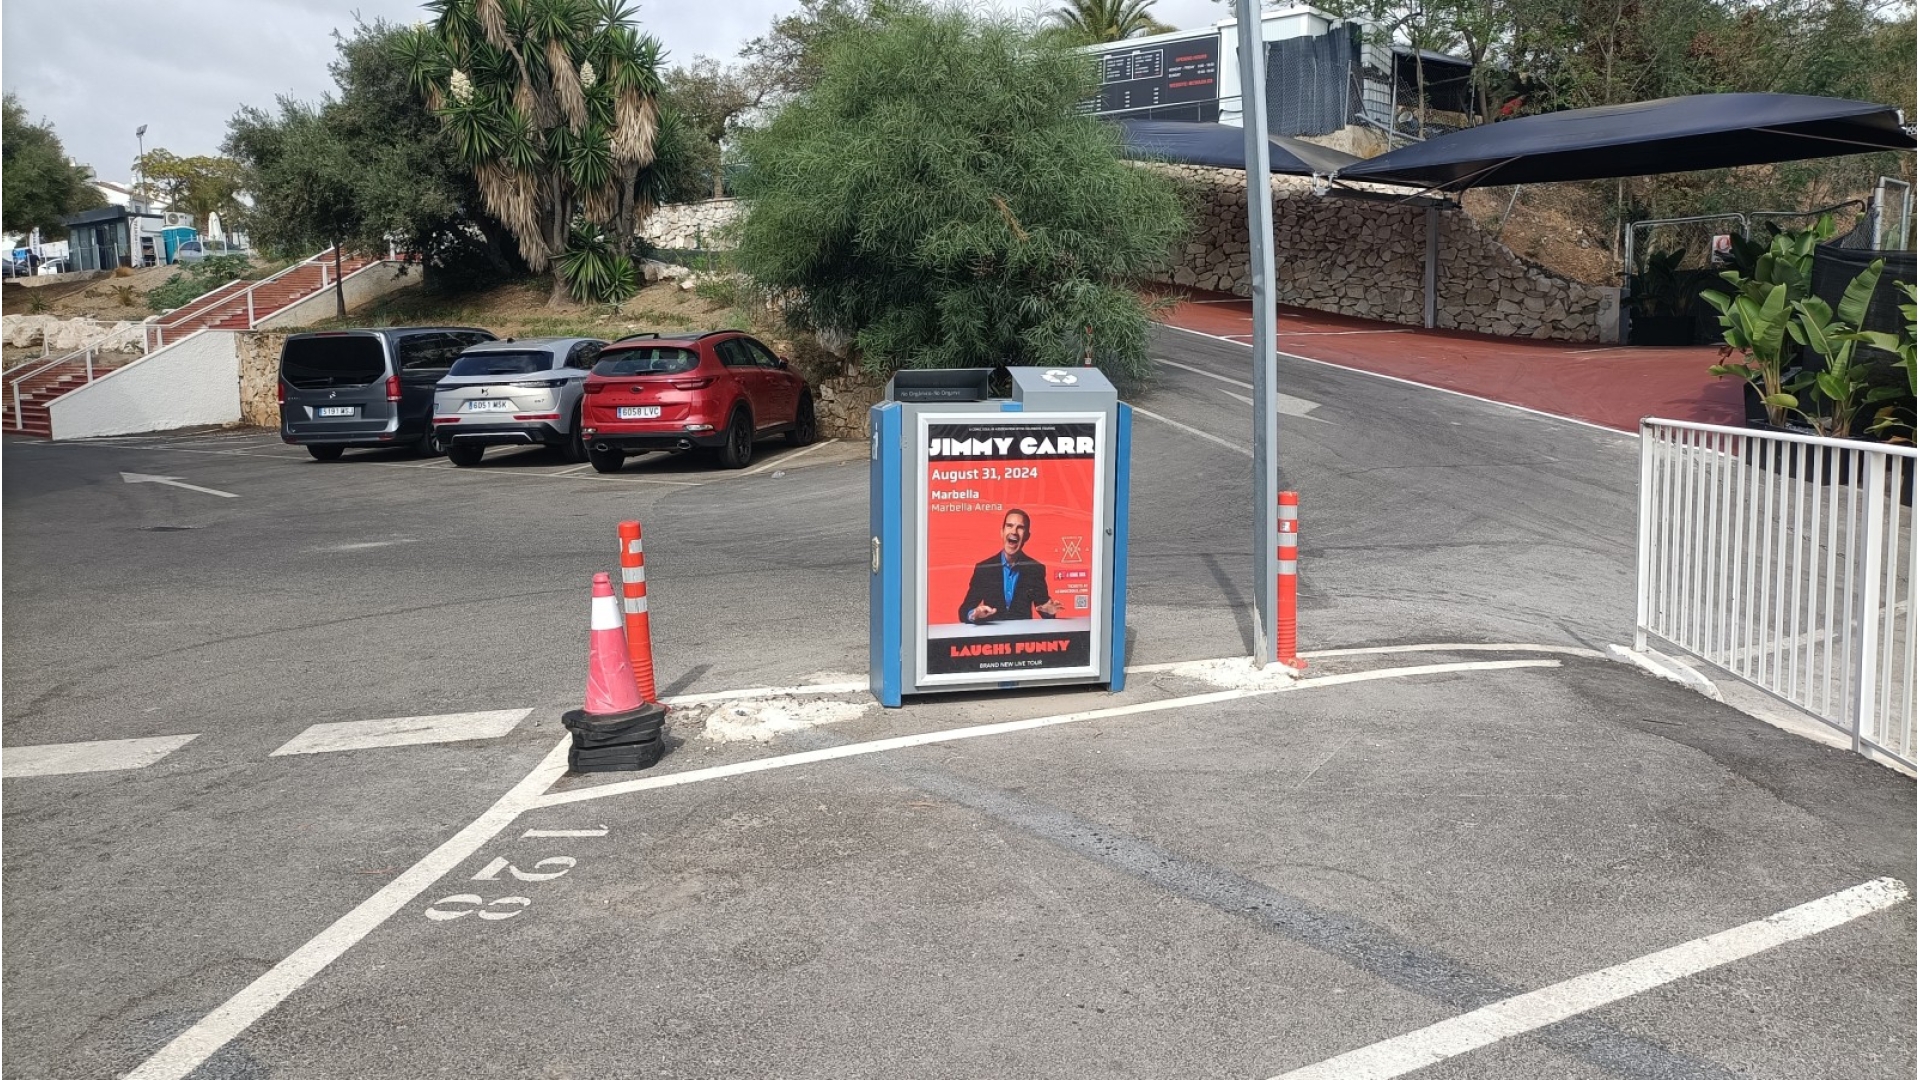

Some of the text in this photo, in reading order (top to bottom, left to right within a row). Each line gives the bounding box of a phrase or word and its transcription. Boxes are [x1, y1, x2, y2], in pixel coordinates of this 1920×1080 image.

[473, 400, 507, 409] 6051 MSK
[622, 406, 659, 416] 6058 LVC
[929, 436, 1095, 456] JIMMY CARR
[931, 467, 1038, 482] August 31, 2024
[931, 490, 979, 500] Marbella
[931, 502, 1003, 512] Marbella Arena
[950, 640, 1070, 657] LAUGHS FUNNY
[425, 824, 609, 921] 128
